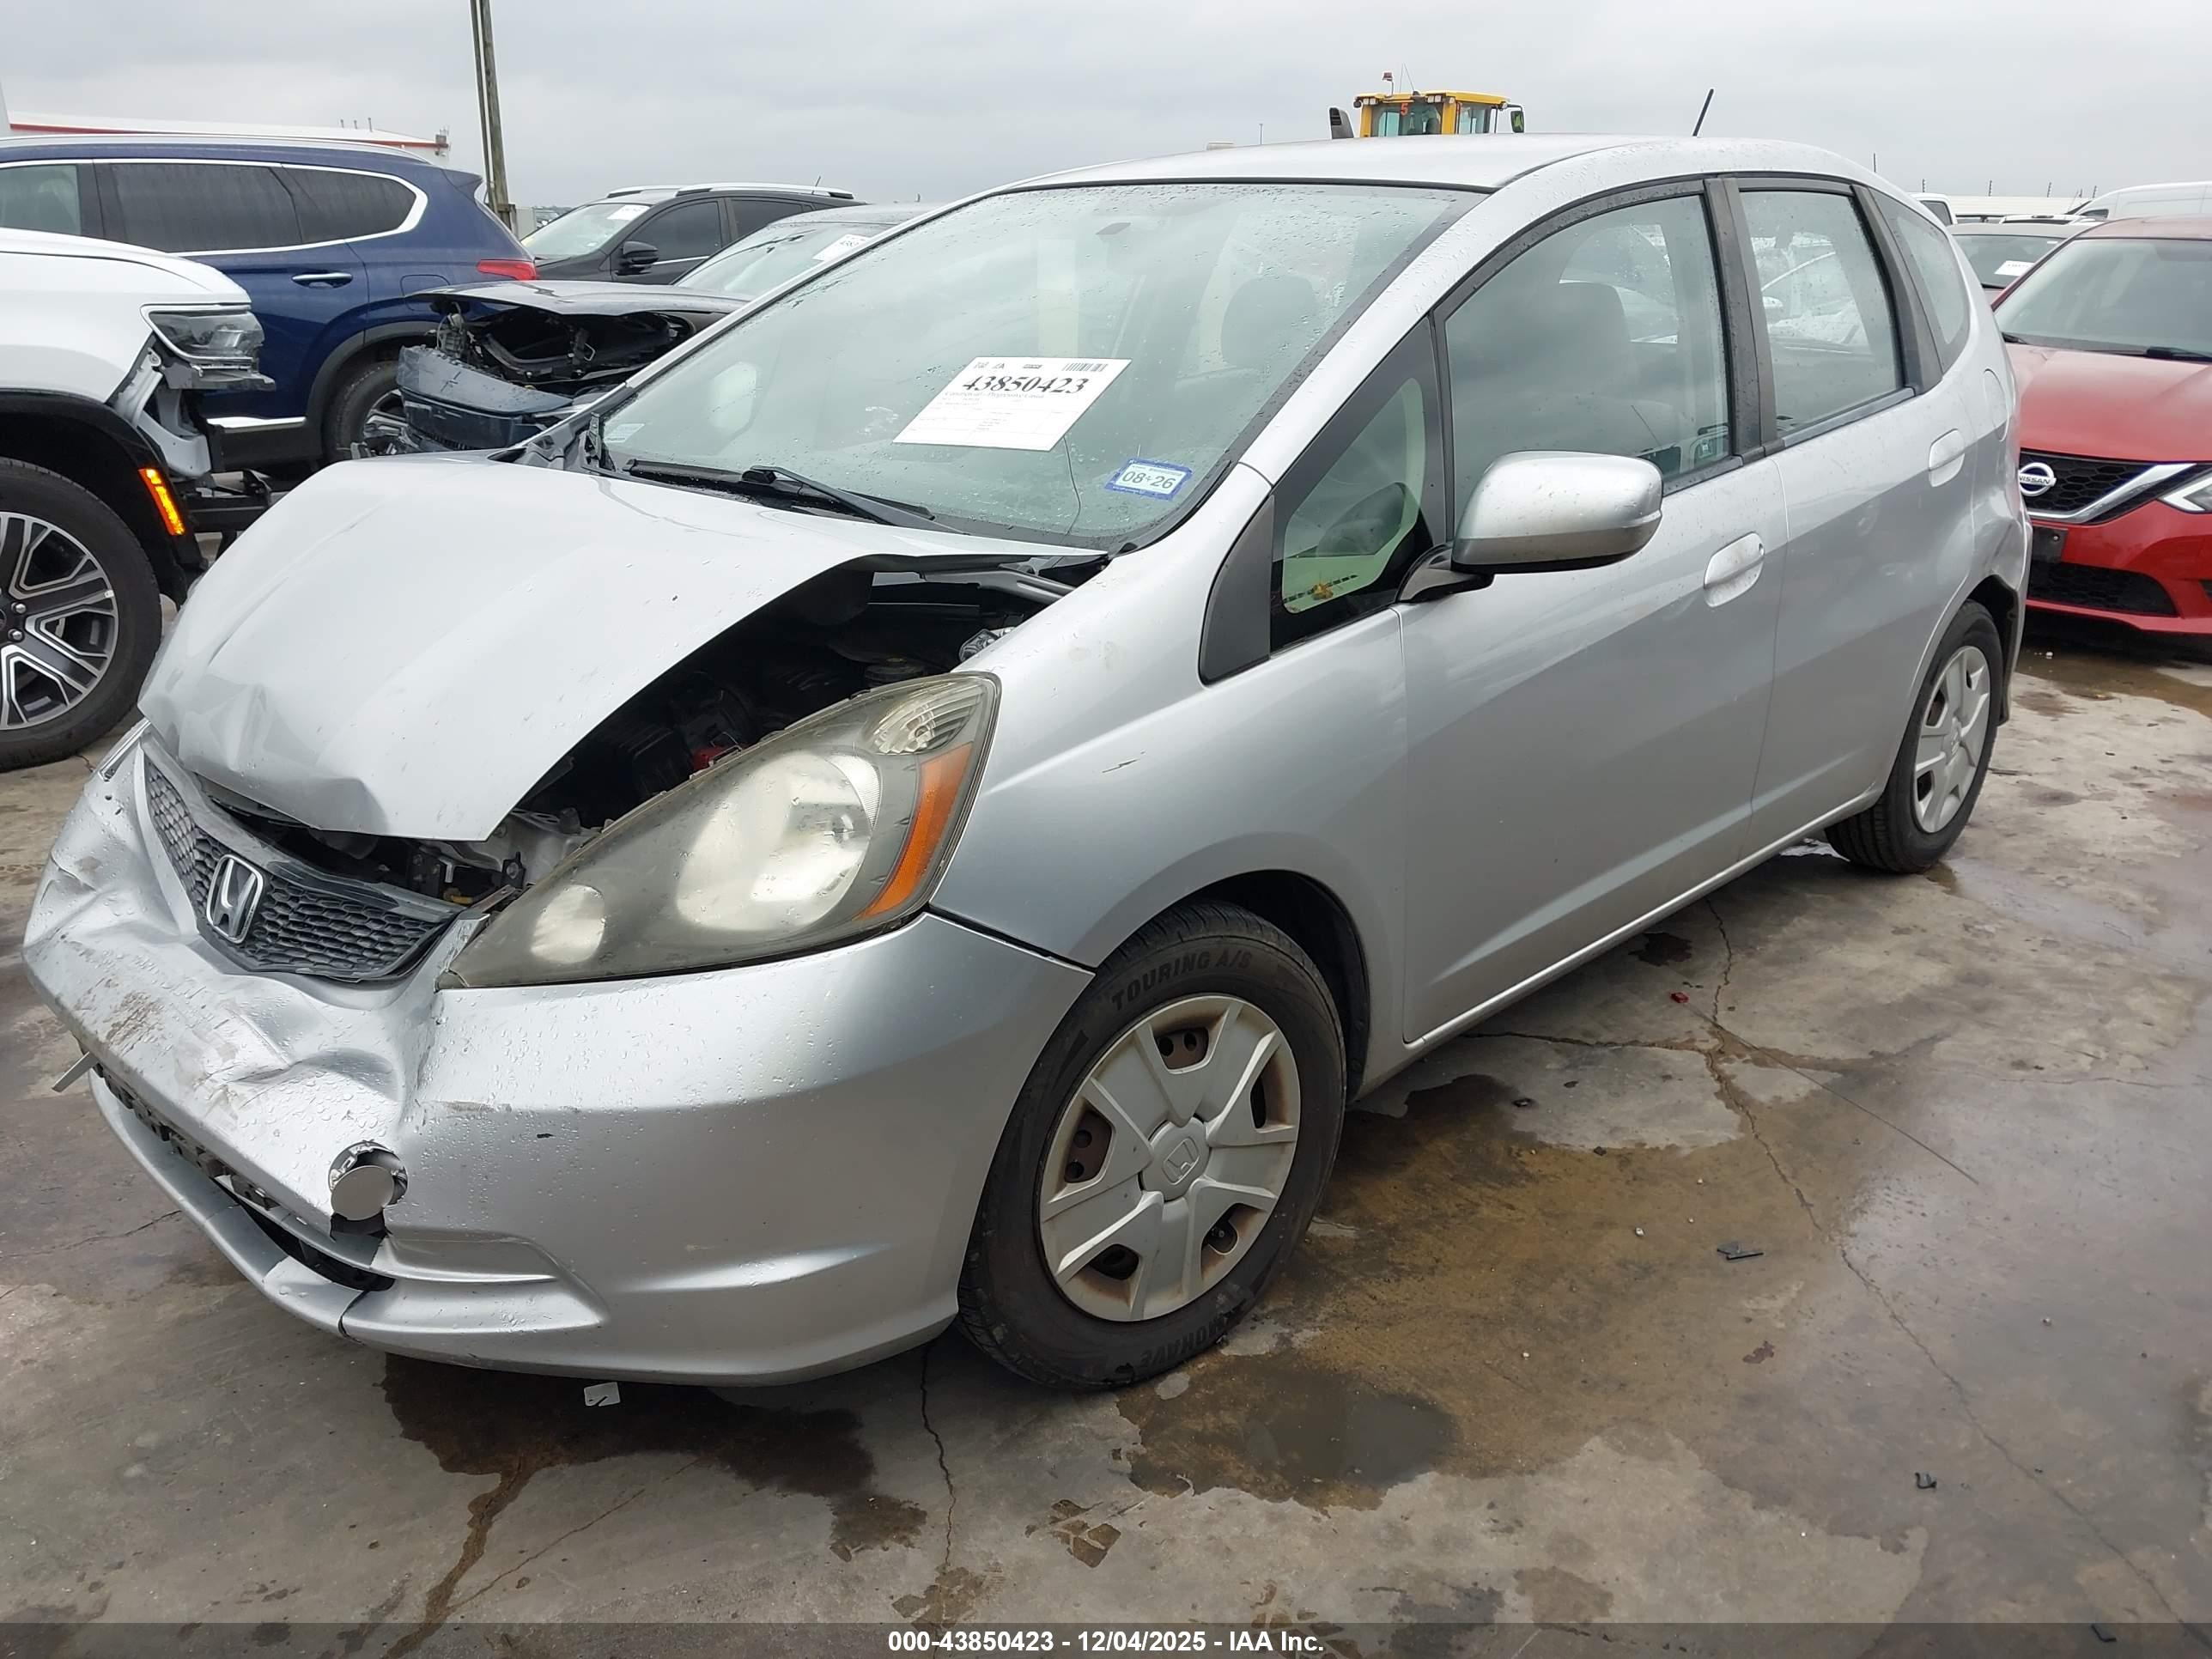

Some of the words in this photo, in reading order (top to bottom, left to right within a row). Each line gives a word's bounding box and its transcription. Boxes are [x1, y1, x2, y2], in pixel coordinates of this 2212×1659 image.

[1401, 102, 1408, 115] 5
[963, 375, 1089, 394] 43850423
[1122, 471, 1146, 483] 08
[1151, 476, 1176, 489] 26
[2019, 476, 2051, 484] NISSAN
[1111, 951, 1212, 1011] TOURING
[1215, 948, 1253, 969] A/S
